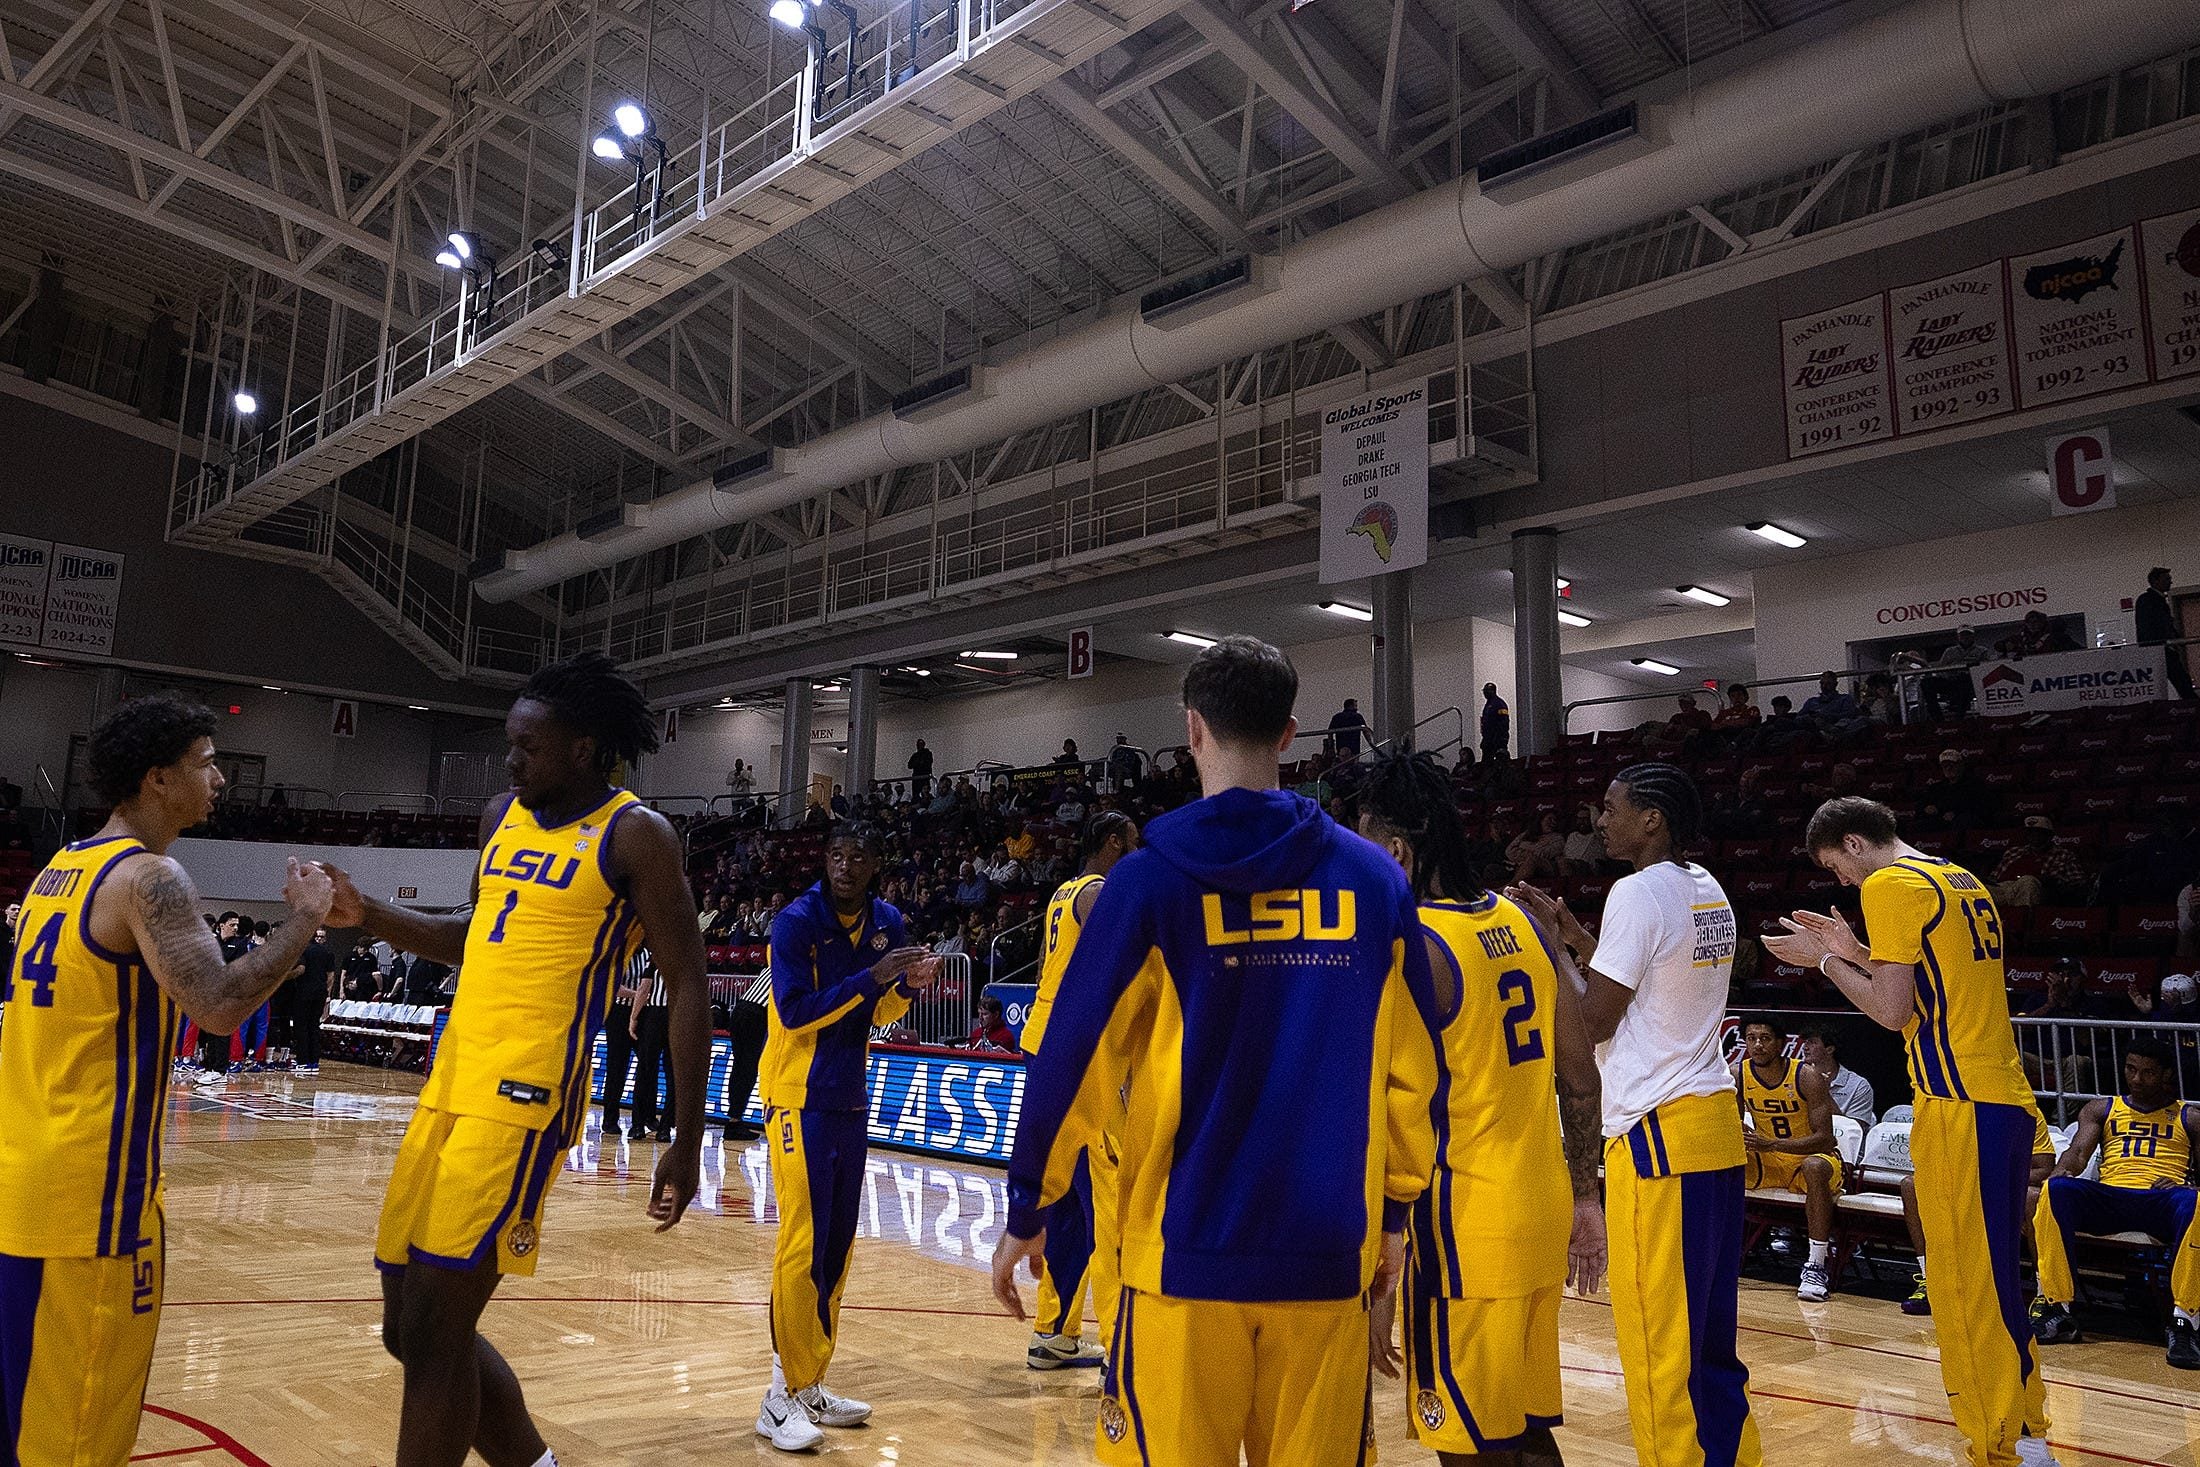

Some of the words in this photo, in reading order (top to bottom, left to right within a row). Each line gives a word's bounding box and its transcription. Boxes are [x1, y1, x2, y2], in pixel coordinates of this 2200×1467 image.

[1901, 282, 1992, 315] PANHANDLE
[1792, 315, 1875, 346] PANHANDLE
[1917, 311, 1965, 333] LADY
[2040, 308, 2117, 335] NATIONAL
[2040, 320, 2117, 345] WOMEN'S
[1807, 343, 1850, 363] LADY
[1901, 320, 1997, 359] RAIDERS
[2025, 328, 2136, 362] TOURNAMENT
[2171, 345, 2197, 367] 19
[1792, 352, 1880, 388] RAIDERS
[1905, 355, 1998, 385] CONFERENCE
[1909, 370, 1995, 397] CHAMPIONS
[1325, 400, 1372, 424] Global
[1374, 389, 1423, 412] Sports
[1795, 384, 1881, 413] CONFERENCE
[1341, 409, 1400, 433] WELCOMES
[1799, 400, 1877, 425] CHAMPIONS
[1356, 431, 1386, 449] DEPAUL
[1358, 448, 1384, 466] DRAKE
[1342, 468, 1378, 487] GEORGIA
[1380, 462, 1400, 478] TECH
[2055, 436, 2105, 507] C
[1363, 485, 1379, 499] LSU
[0, 544, 43, 567] JCAA
[58, 555, 117, 580] NJCAA
[0, 590, 39, 606] IONAL
[51, 598, 113, 617] NATIONAL
[1876, 587, 2047, 624] CONCESSIONS
[0, 623, 33, 637] 2-23
[47, 611, 114, 630] CHAMPIONS
[50, 630, 107, 646] 2024-25
[1071, 631, 1089, 675] B
[1986, 687, 2023, 701] ERA
[2029, 667, 2154, 694] AMERICAN
[2079, 689, 2108, 702] REAL
[2113, 684, 2155, 699] ESTATE
[333, 703, 353, 735] A
[665, 711, 676, 743] A
[483, 844, 580, 889] LSU
[400, 887, 416, 898] EXIT
[488, 890, 517, 942] 1
[1202, 889, 1356, 946] LSU
[1961, 898, 2001, 961] 13
[1050, 908, 1062, 953] 6
[1477, 926, 1522, 959] REECE
[1498, 969, 1545, 1067] 2
[866, 1056, 1027, 1158] LASSI
[1748, 1097, 1799, 1115] LSU
[780, 1110, 794, 1154] LSU
[1771, 1117, 1792, 1139] 8
[2111, 1120, 2173, 1139] LSU
[2120, 1137, 2157, 1158] 10
[133, 1238, 153, 1315] LSU
